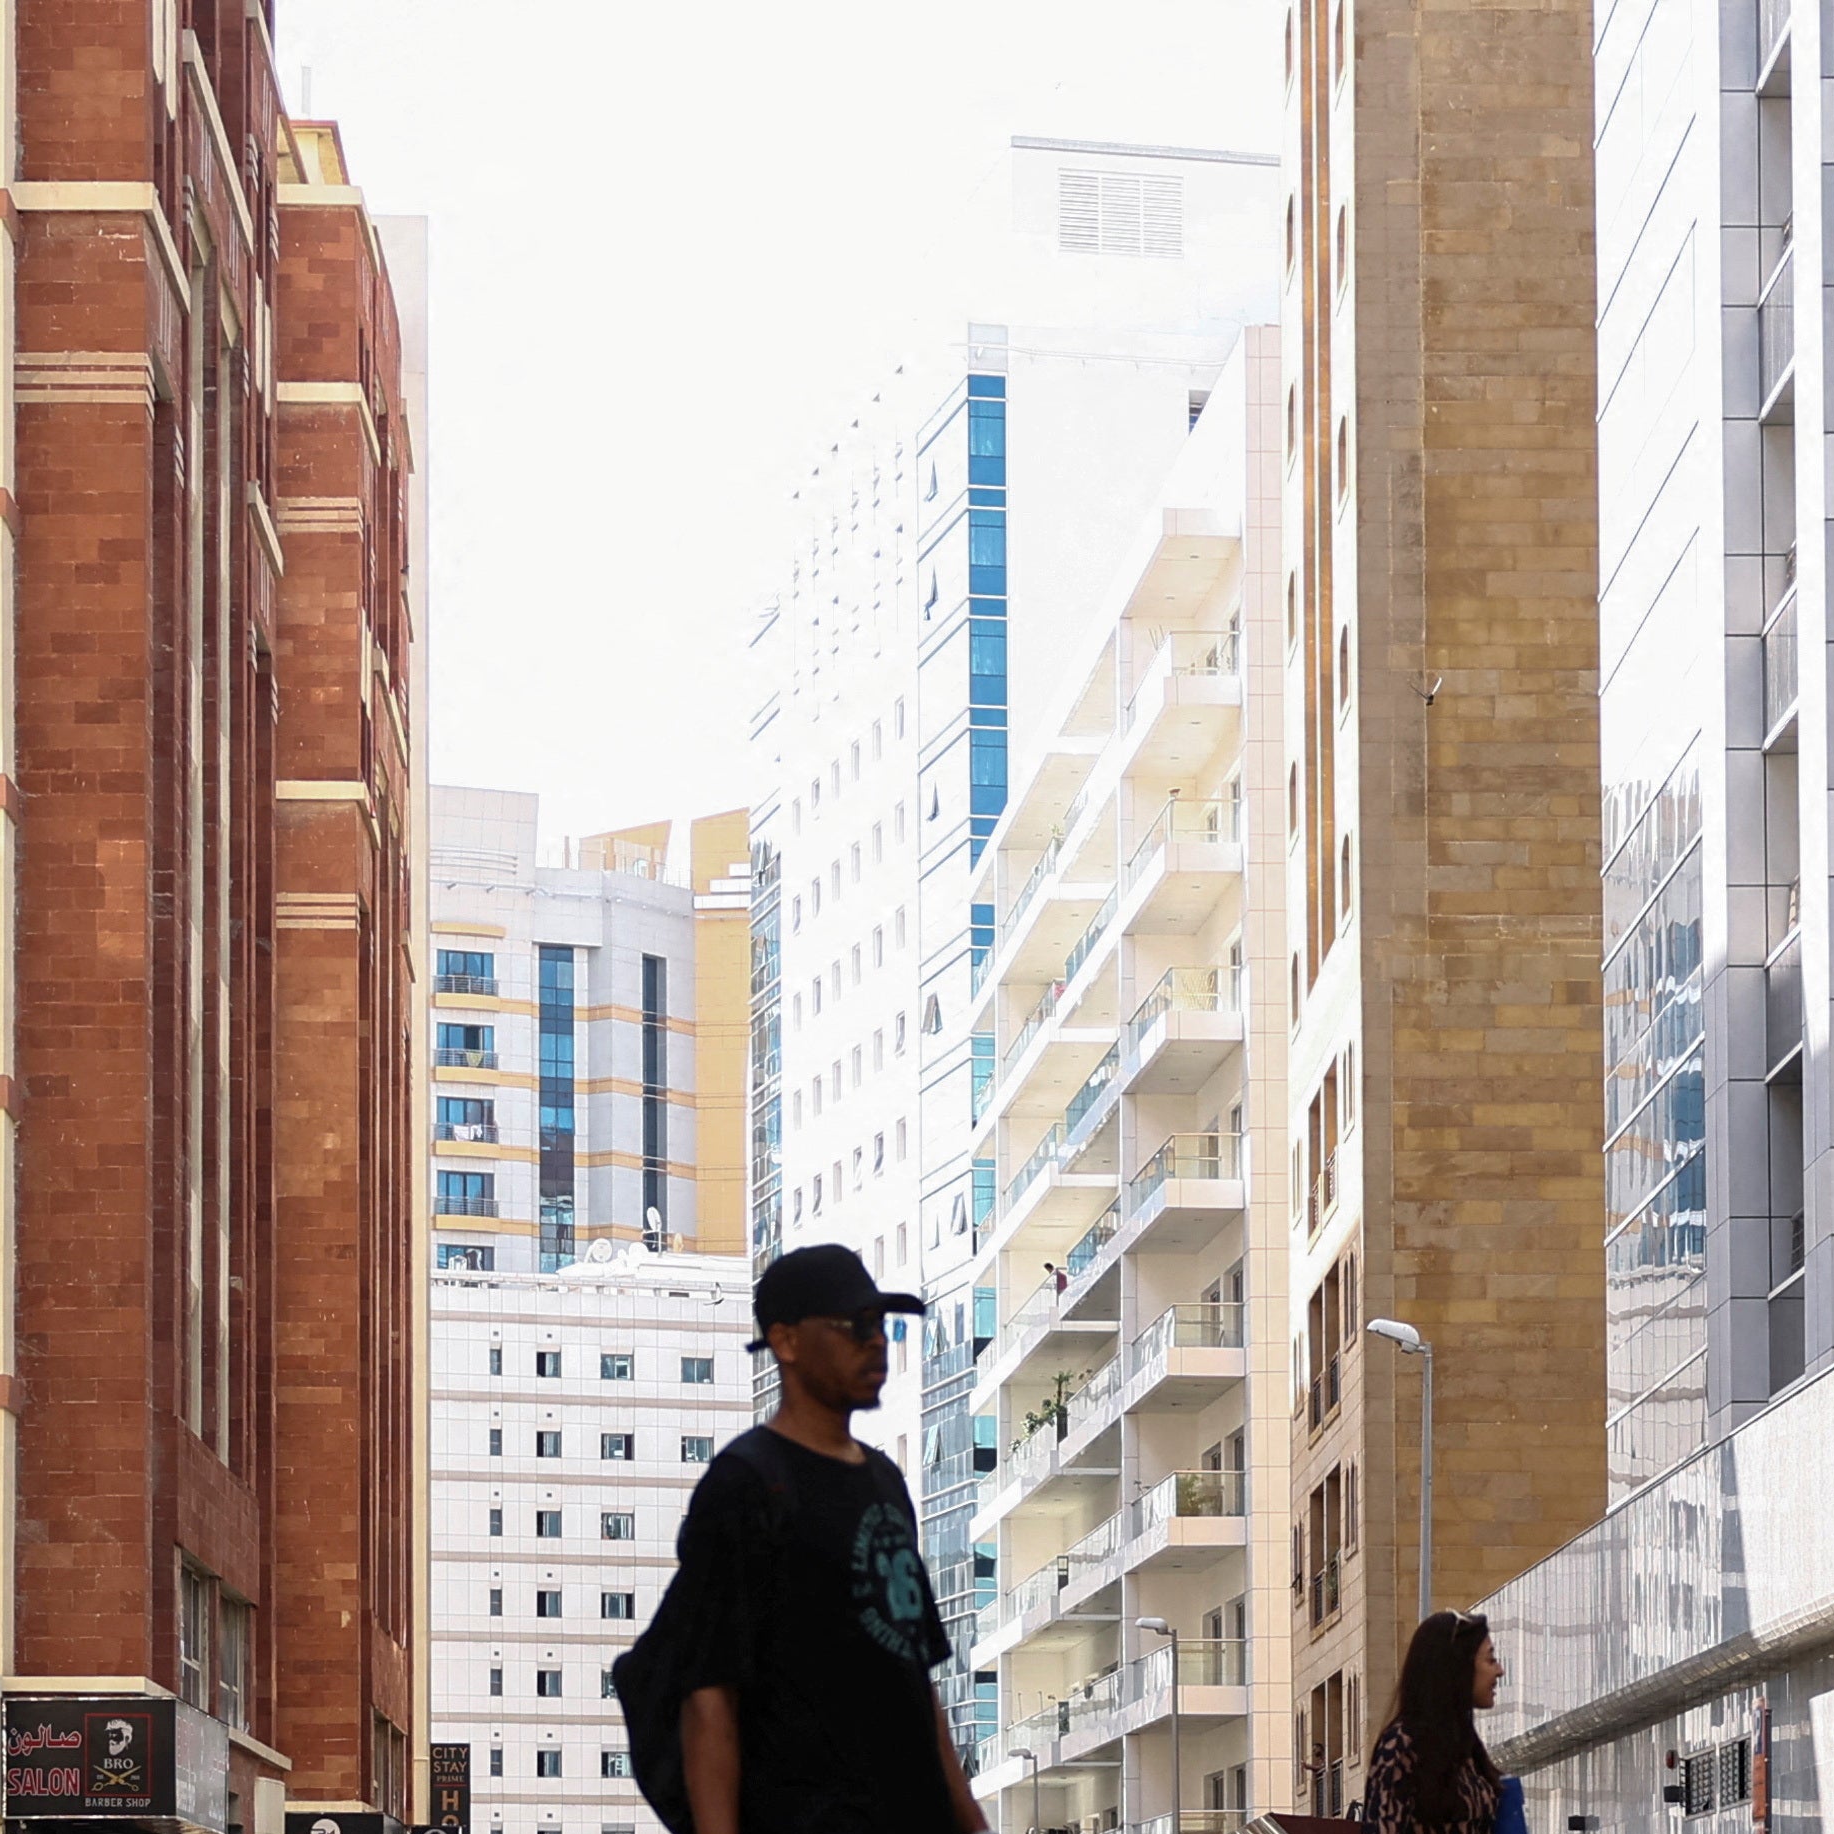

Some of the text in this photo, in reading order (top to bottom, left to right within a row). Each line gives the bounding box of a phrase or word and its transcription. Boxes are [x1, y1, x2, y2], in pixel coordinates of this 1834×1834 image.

[7, 1723, 82, 1756] صالون
[432, 1746, 468, 1760] CITY
[103, 1757, 134, 1769] BRO
[433, 1761, 467, 1773] STAY
[7, 1767, 80, 1796] SALON
[436, 1775, 465, 1783] PRIME
[85, 1797, 151, 1808] BARBER SHOP
